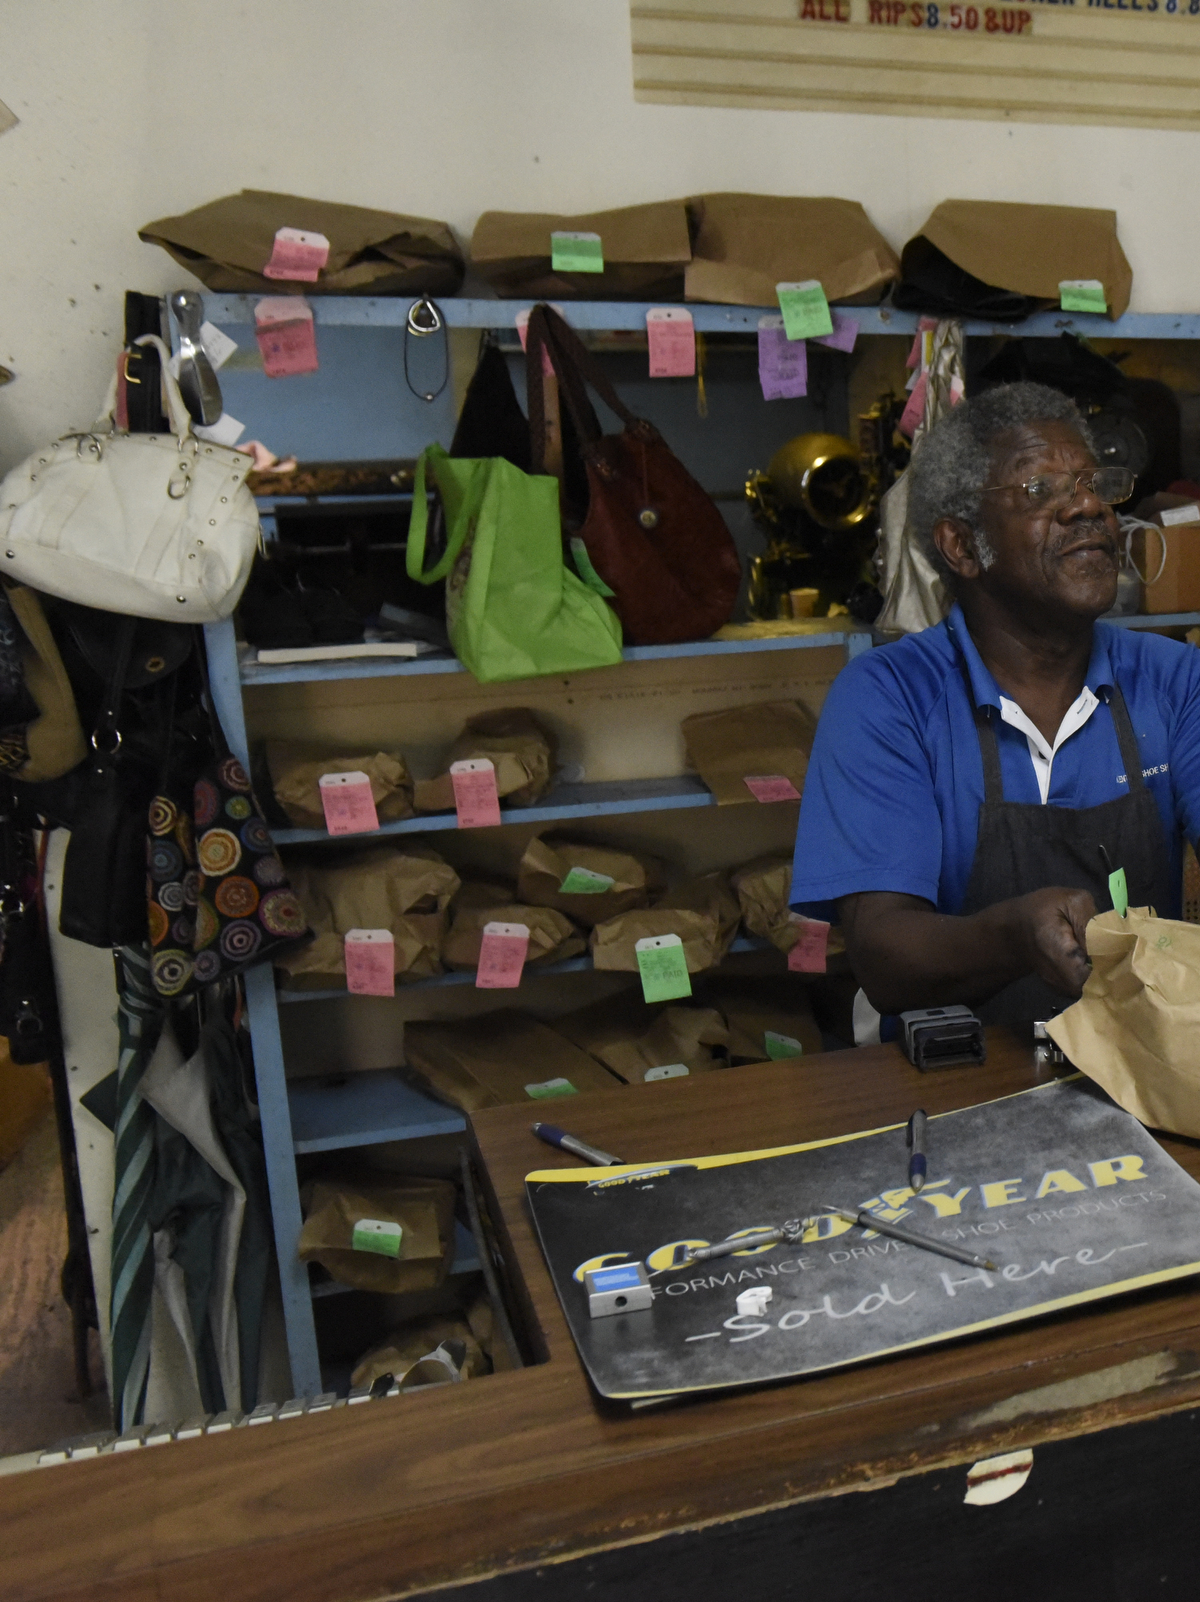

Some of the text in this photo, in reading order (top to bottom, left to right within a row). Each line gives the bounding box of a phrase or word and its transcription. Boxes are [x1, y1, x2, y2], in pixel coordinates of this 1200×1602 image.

[801, 0, 848, 22] ALL
[650, 1256, 816, 1301] FORMANCE
[941, 1218, 1016, 1241] SHOE
[1026, 1190, 1167, 1225] PRODUCTS
